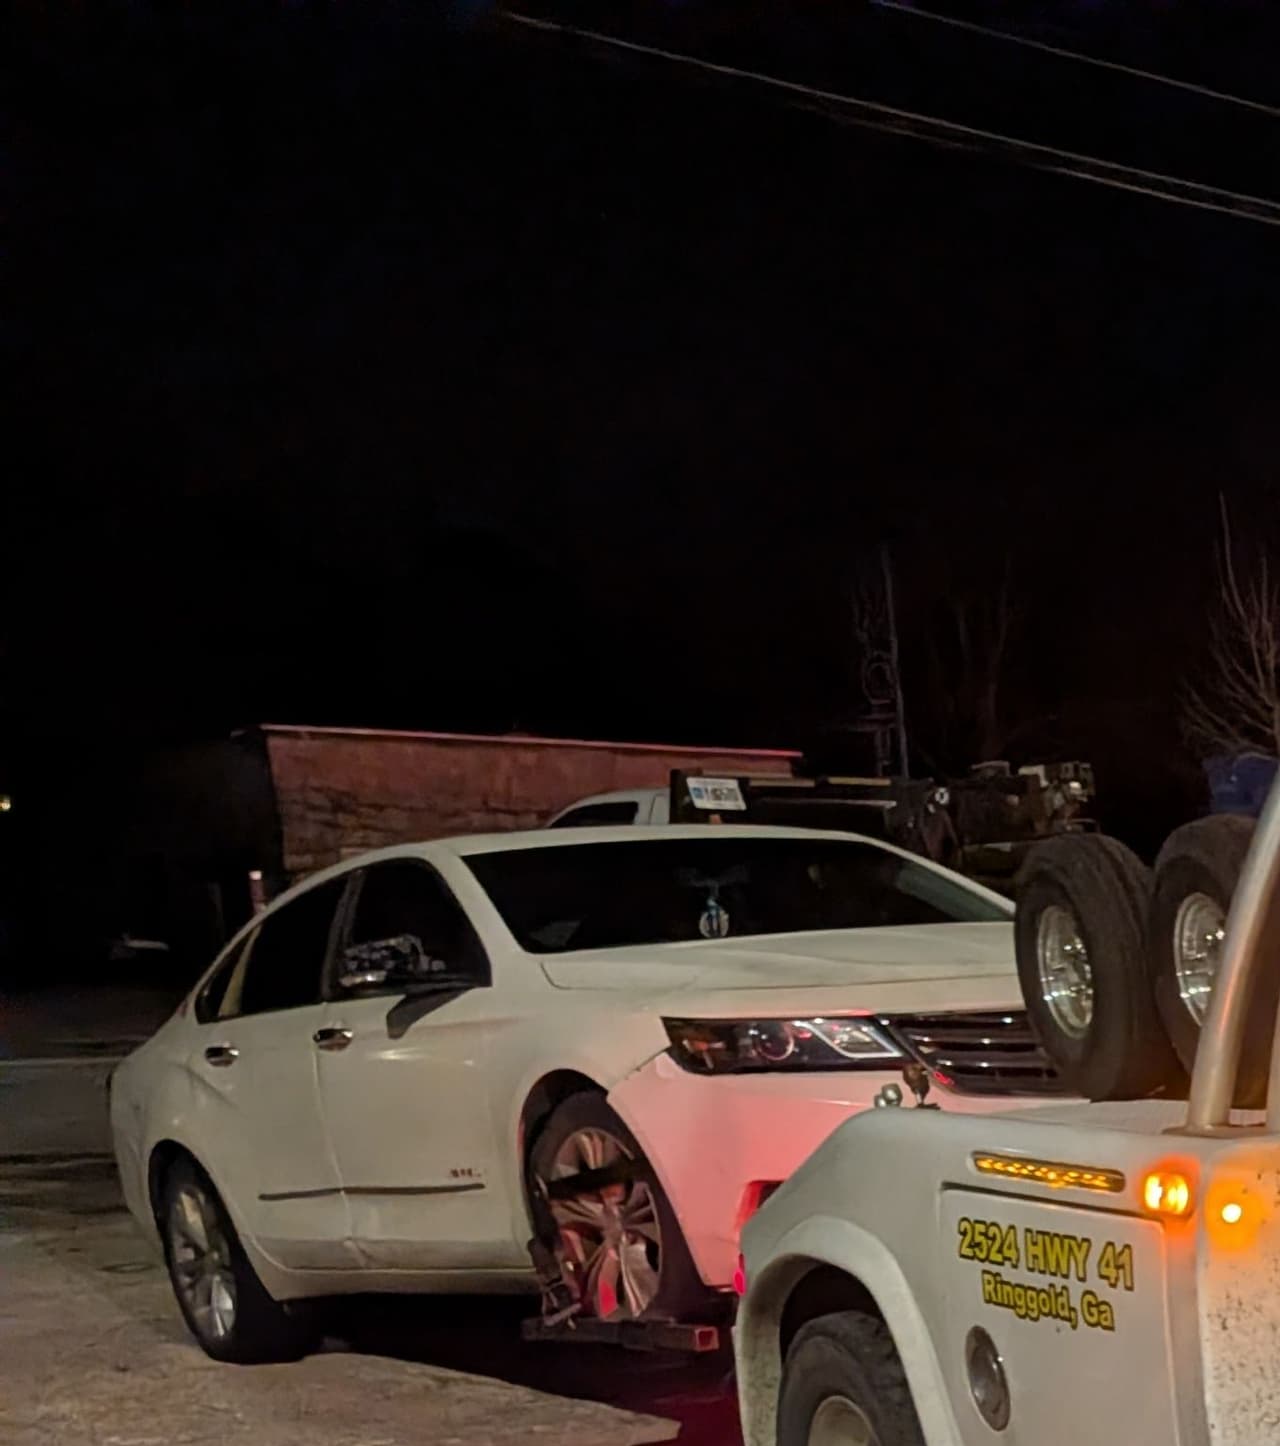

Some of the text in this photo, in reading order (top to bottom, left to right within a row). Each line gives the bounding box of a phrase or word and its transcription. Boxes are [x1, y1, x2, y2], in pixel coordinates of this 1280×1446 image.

[958, 1217, 1134, 1291] 2524 HWY 41
[982, 1269, 1116, 1331] Ringgold, Ga
